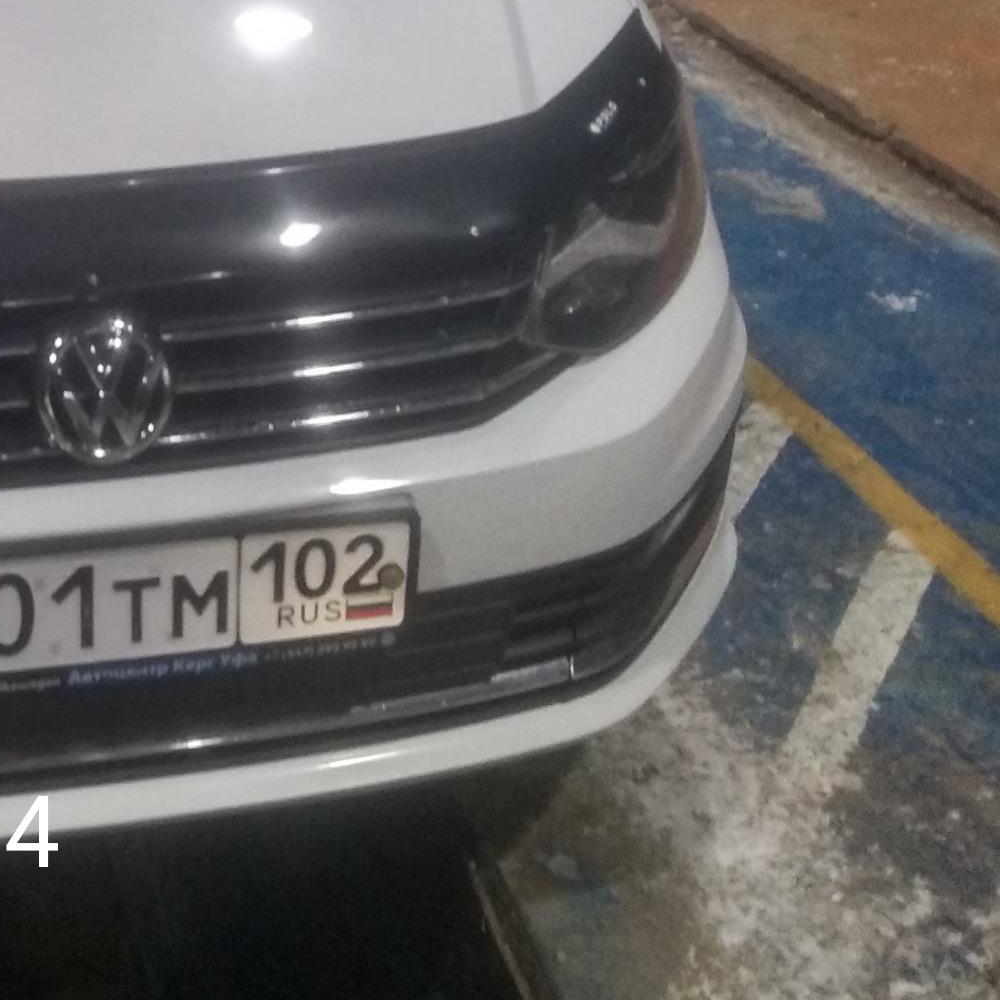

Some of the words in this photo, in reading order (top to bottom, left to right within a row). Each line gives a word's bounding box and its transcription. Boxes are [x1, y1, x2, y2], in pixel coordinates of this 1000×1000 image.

[251, 533, 386, 602] 102
[277, 599, 342, 628] RUS
[67, 662, 169, 686] Автоцентр
